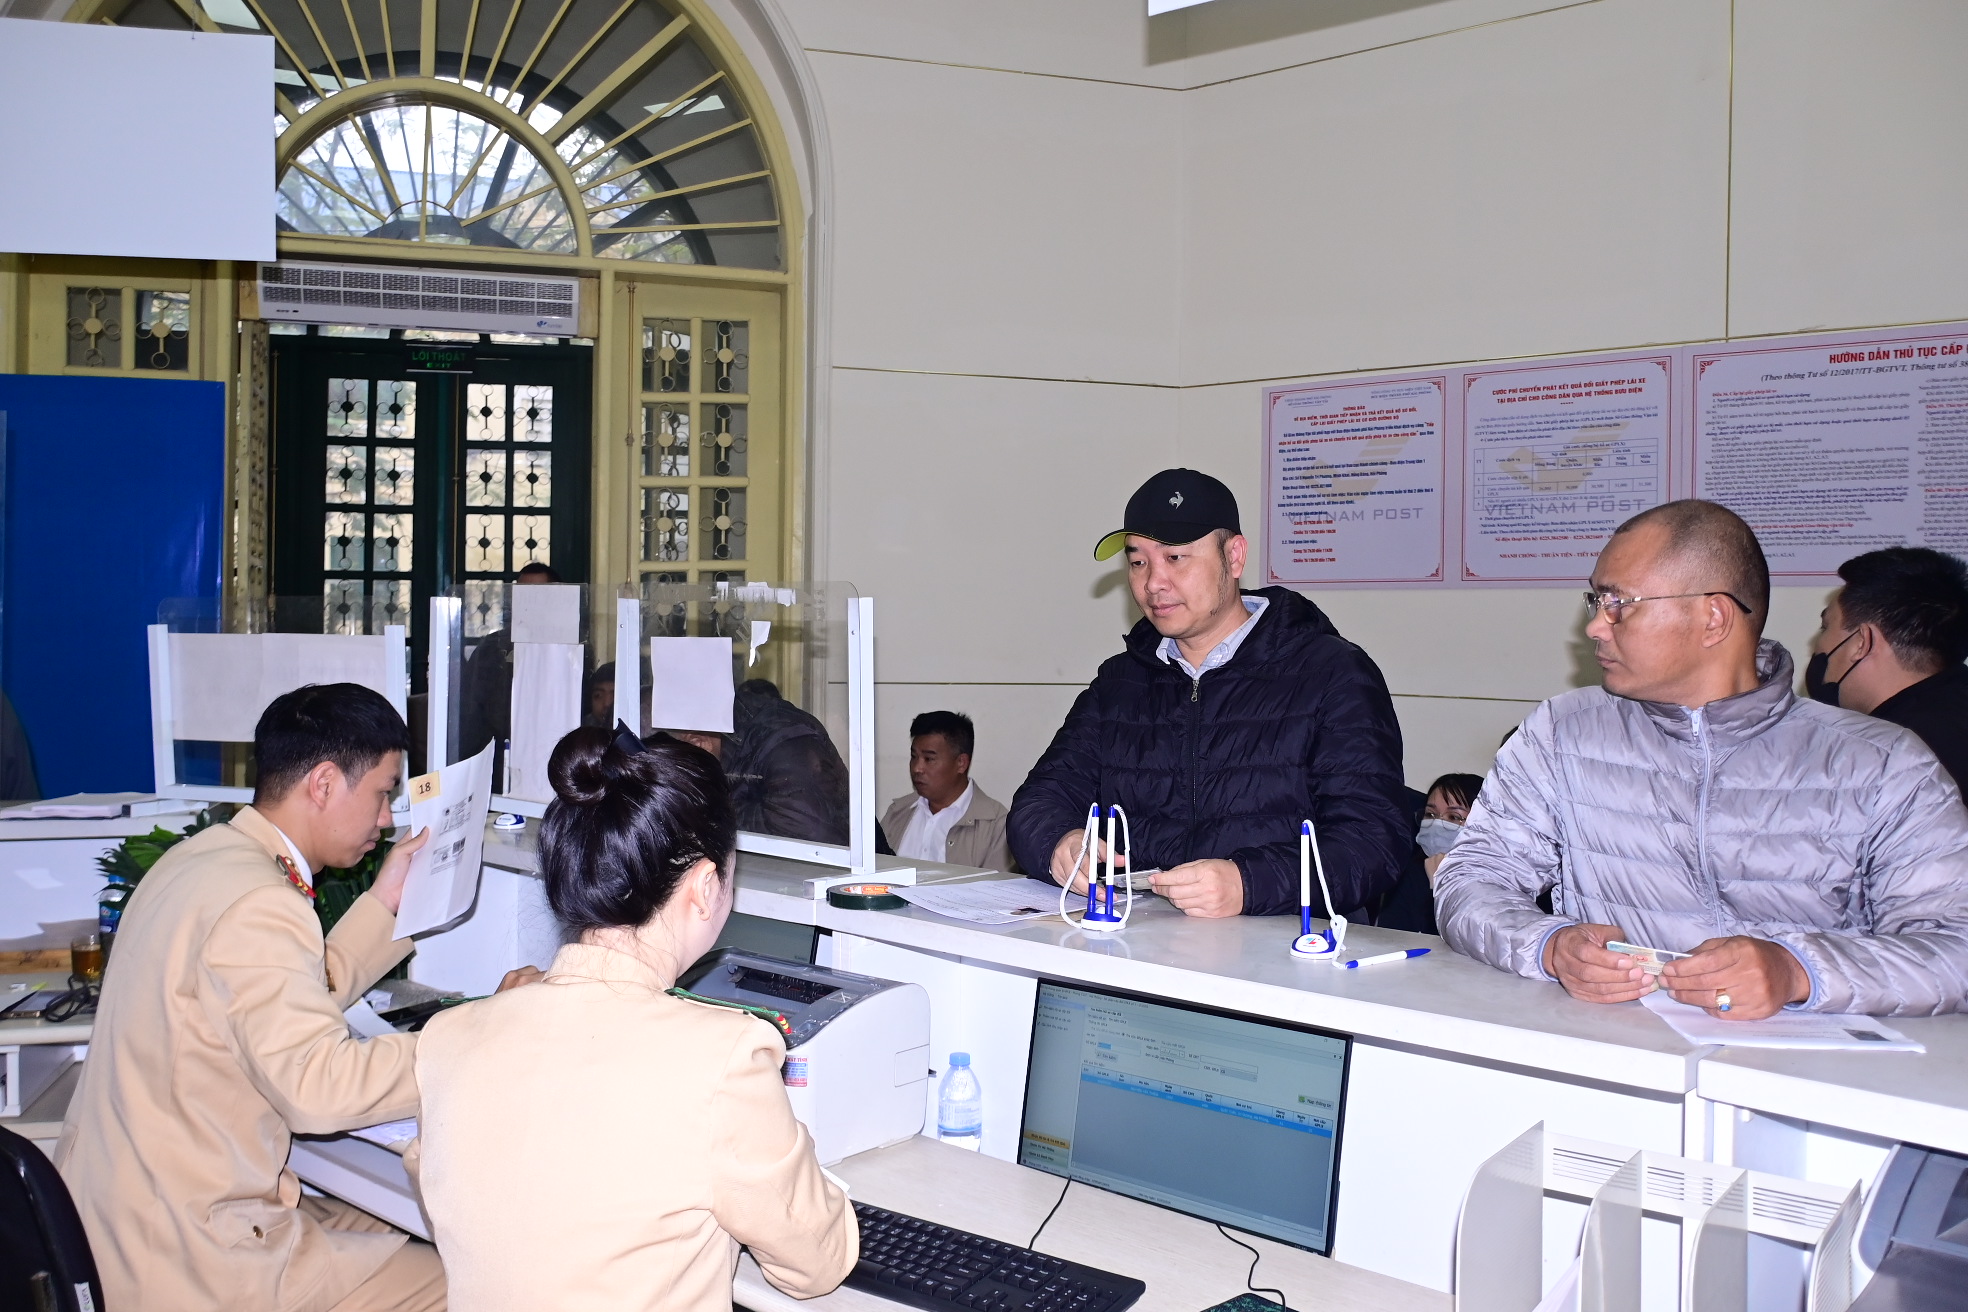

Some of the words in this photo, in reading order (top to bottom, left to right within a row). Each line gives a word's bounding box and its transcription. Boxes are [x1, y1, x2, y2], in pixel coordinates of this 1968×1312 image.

[1829, 350, 1865, 364] HƯỚNG
[1868, 347, 1890, 360] DẪN
[1894, 345, 1914, 359] THỦ
[1917, 346, 1937, 359] TỤC
[1942, 342, 1963, 356] CẤP
[1373, 507, 1423, 522] POST
[1484, 502, 1576, 516] VIETNAM
[1587, 499, 1646, 512] POST
[419, 782, 431, 794] 18
